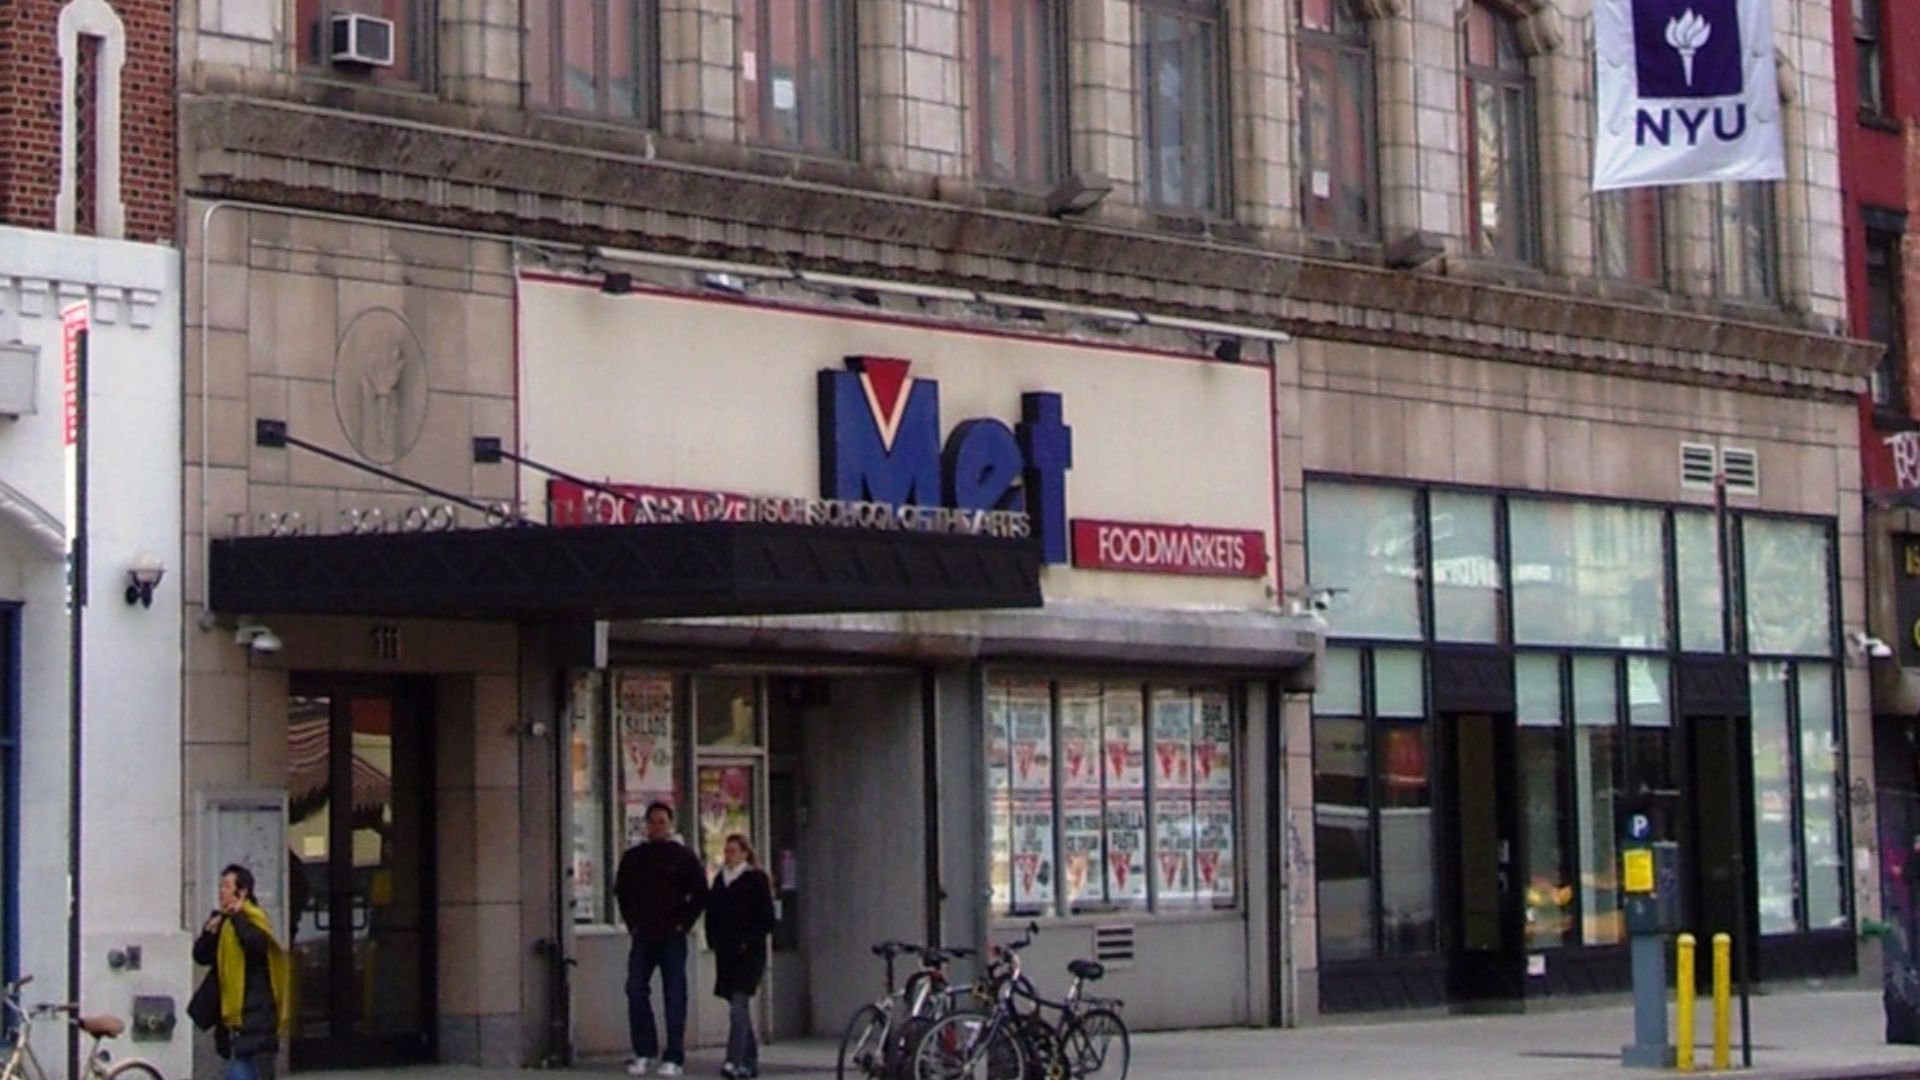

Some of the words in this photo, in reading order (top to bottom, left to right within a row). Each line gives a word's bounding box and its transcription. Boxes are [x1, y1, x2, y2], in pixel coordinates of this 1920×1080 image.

[1635, 103, 1747, 147] NYU
[818, 357, 1073, 565] Met
[969, 508, 1031, 539] ARTS
[1098, 526, 1246, 570] FOODMARKETS
[1632, 814, 1649, 838] P
